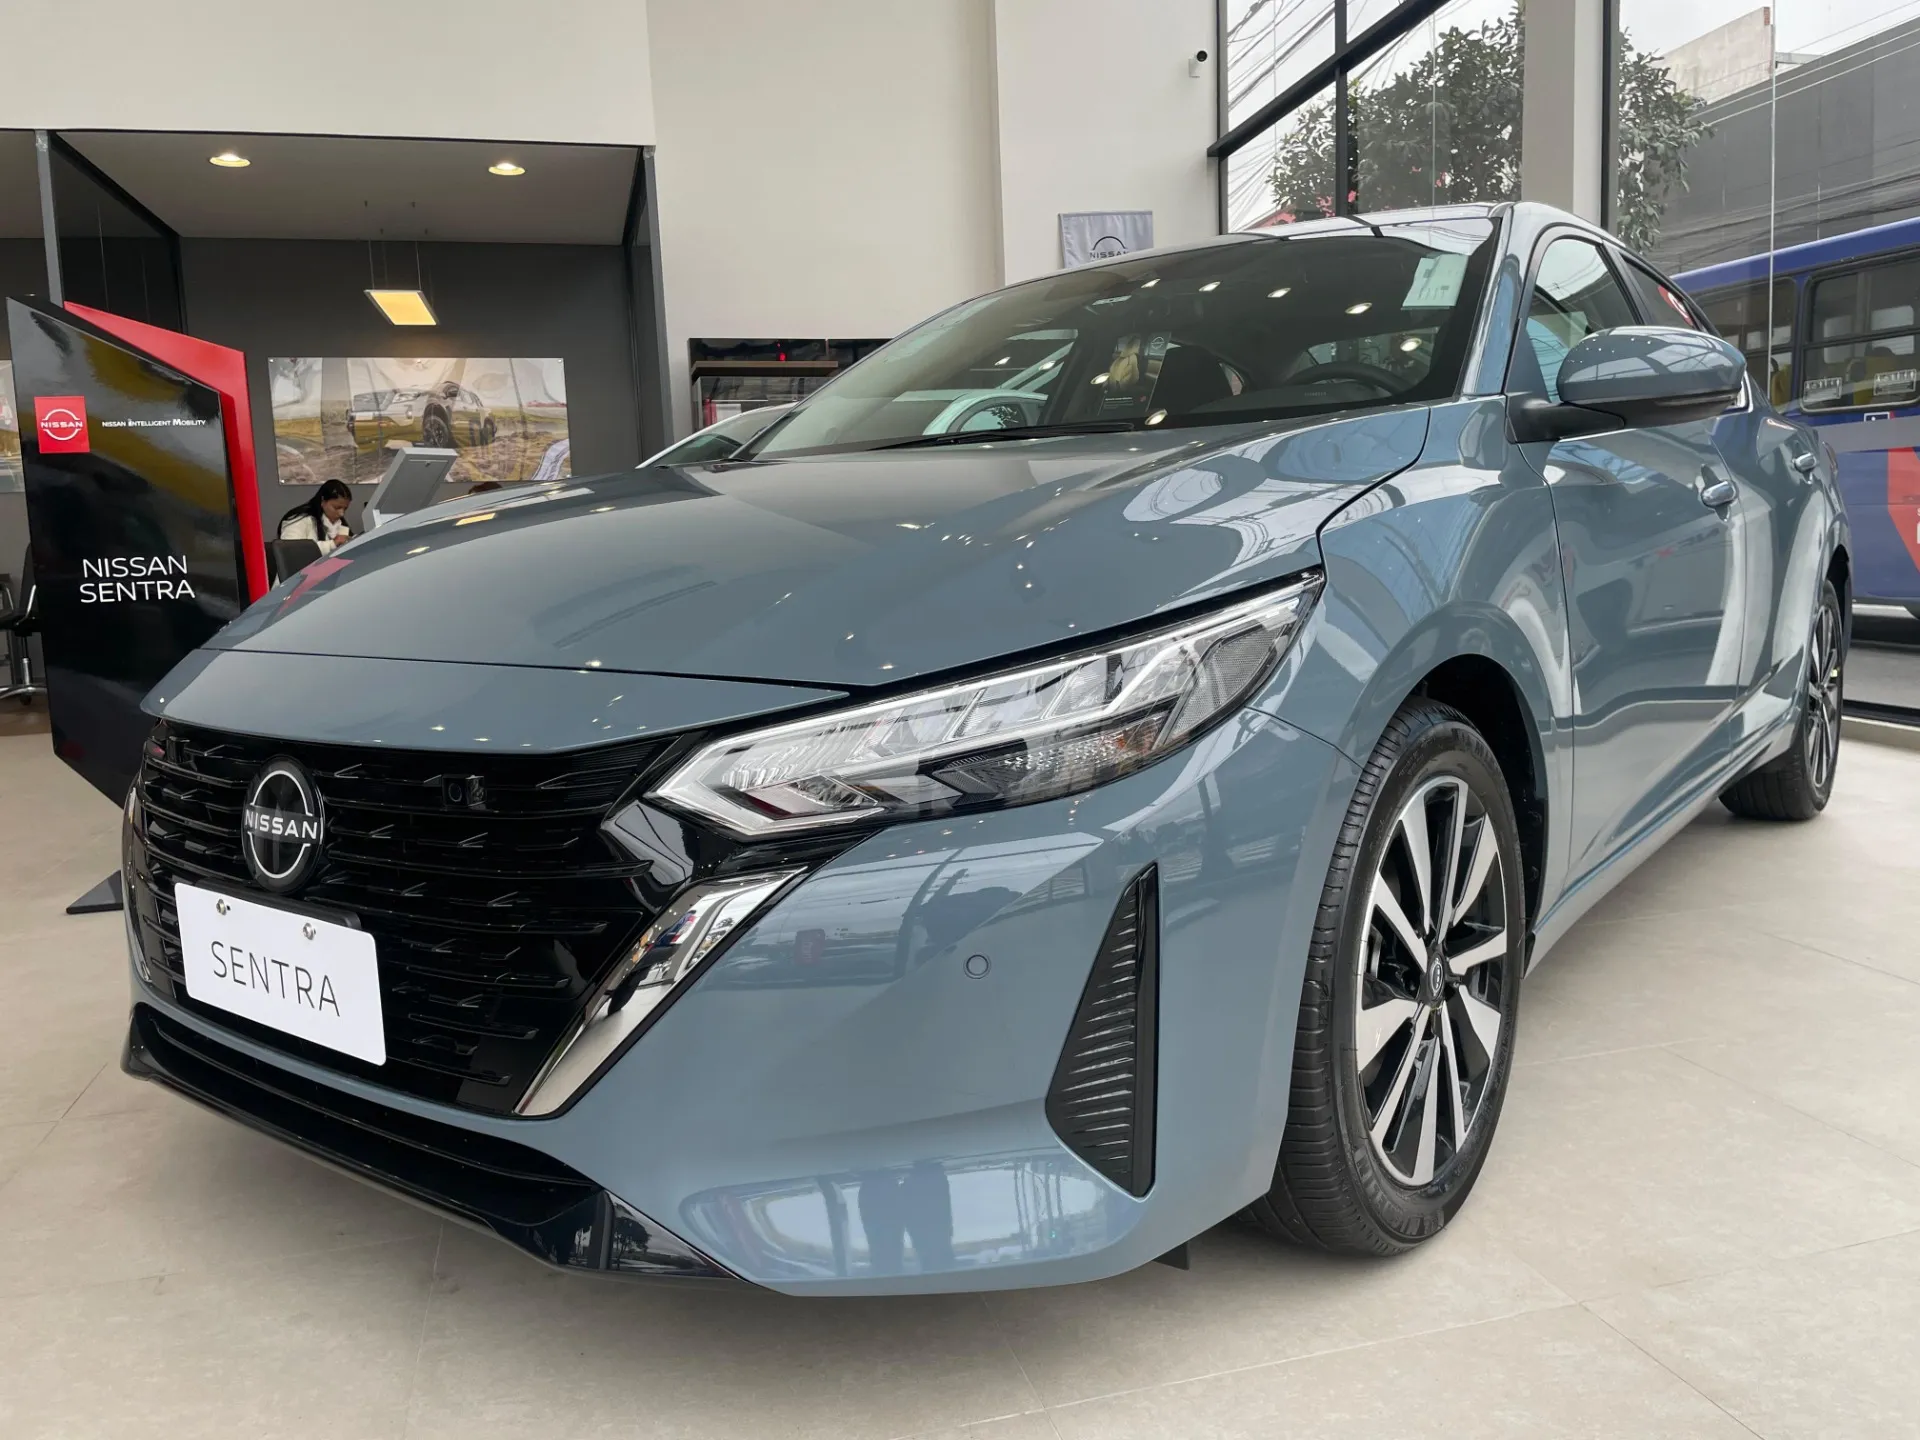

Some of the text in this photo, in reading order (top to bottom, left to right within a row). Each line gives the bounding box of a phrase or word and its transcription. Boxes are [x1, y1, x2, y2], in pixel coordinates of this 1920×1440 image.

[40, 421, 83, 429] NISSAN
[101, 420, 126, 428] NISSAN
[82, 554, 188, 578] NISSAN
[79, 579, 196, 603] SENTRA
[245, 808, 318, 840] NISSAN
[211, 940, 341, 1018] SENTRA
